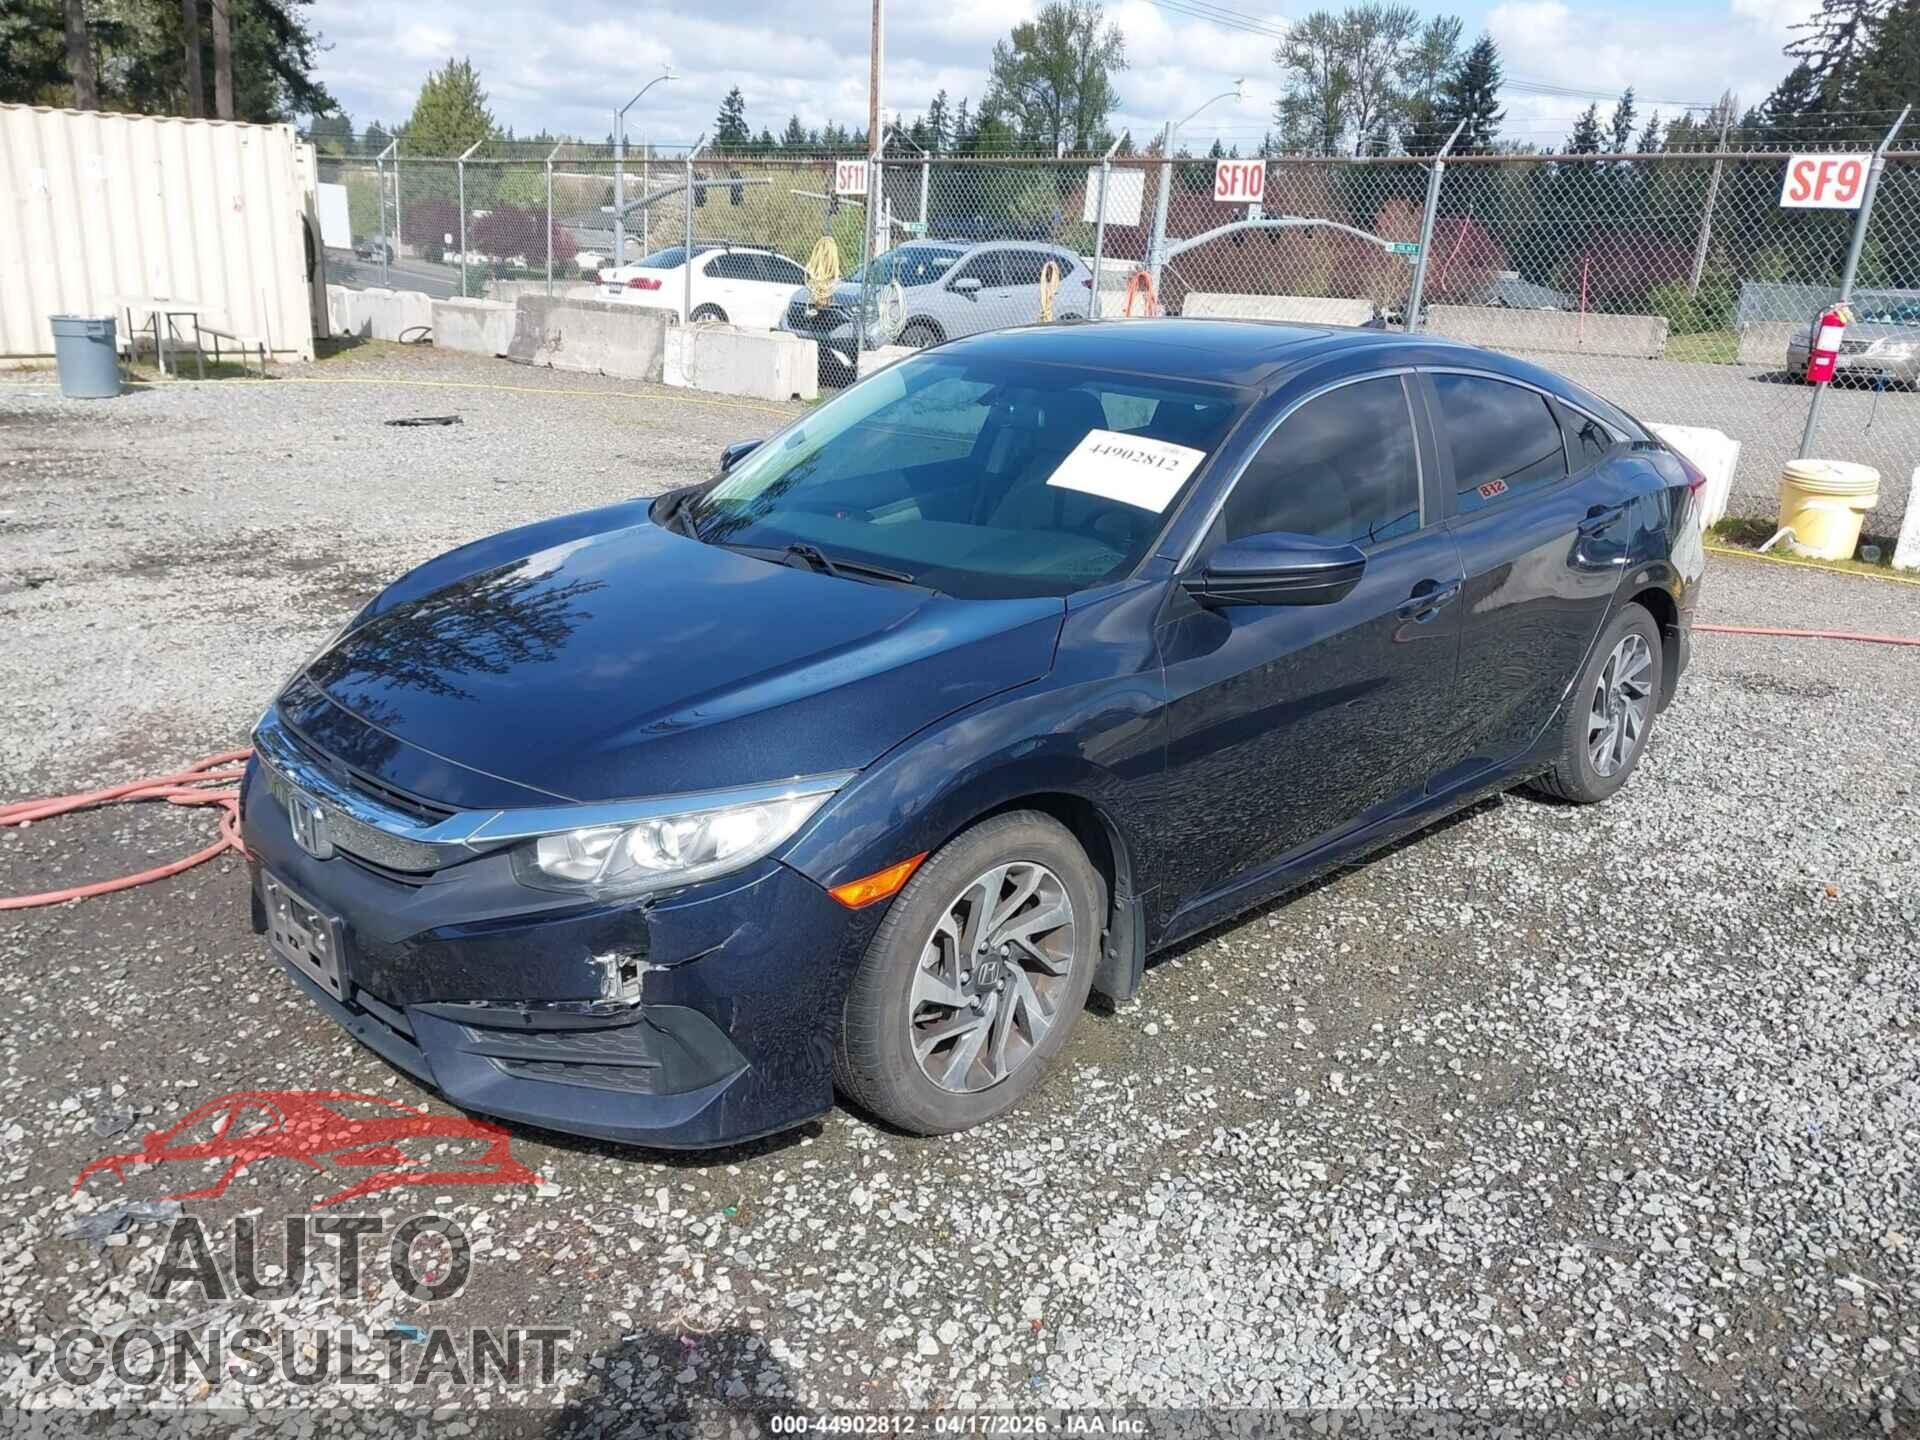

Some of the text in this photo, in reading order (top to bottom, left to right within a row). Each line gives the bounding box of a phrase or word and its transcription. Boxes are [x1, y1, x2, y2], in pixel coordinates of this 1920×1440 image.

[839, 164, 865, 190] SF11
[1217, 164, 1263, 196] SF10
[1790, 160, 1862, 202] SF9
[1089, 443, 1180, 472] 44902812
